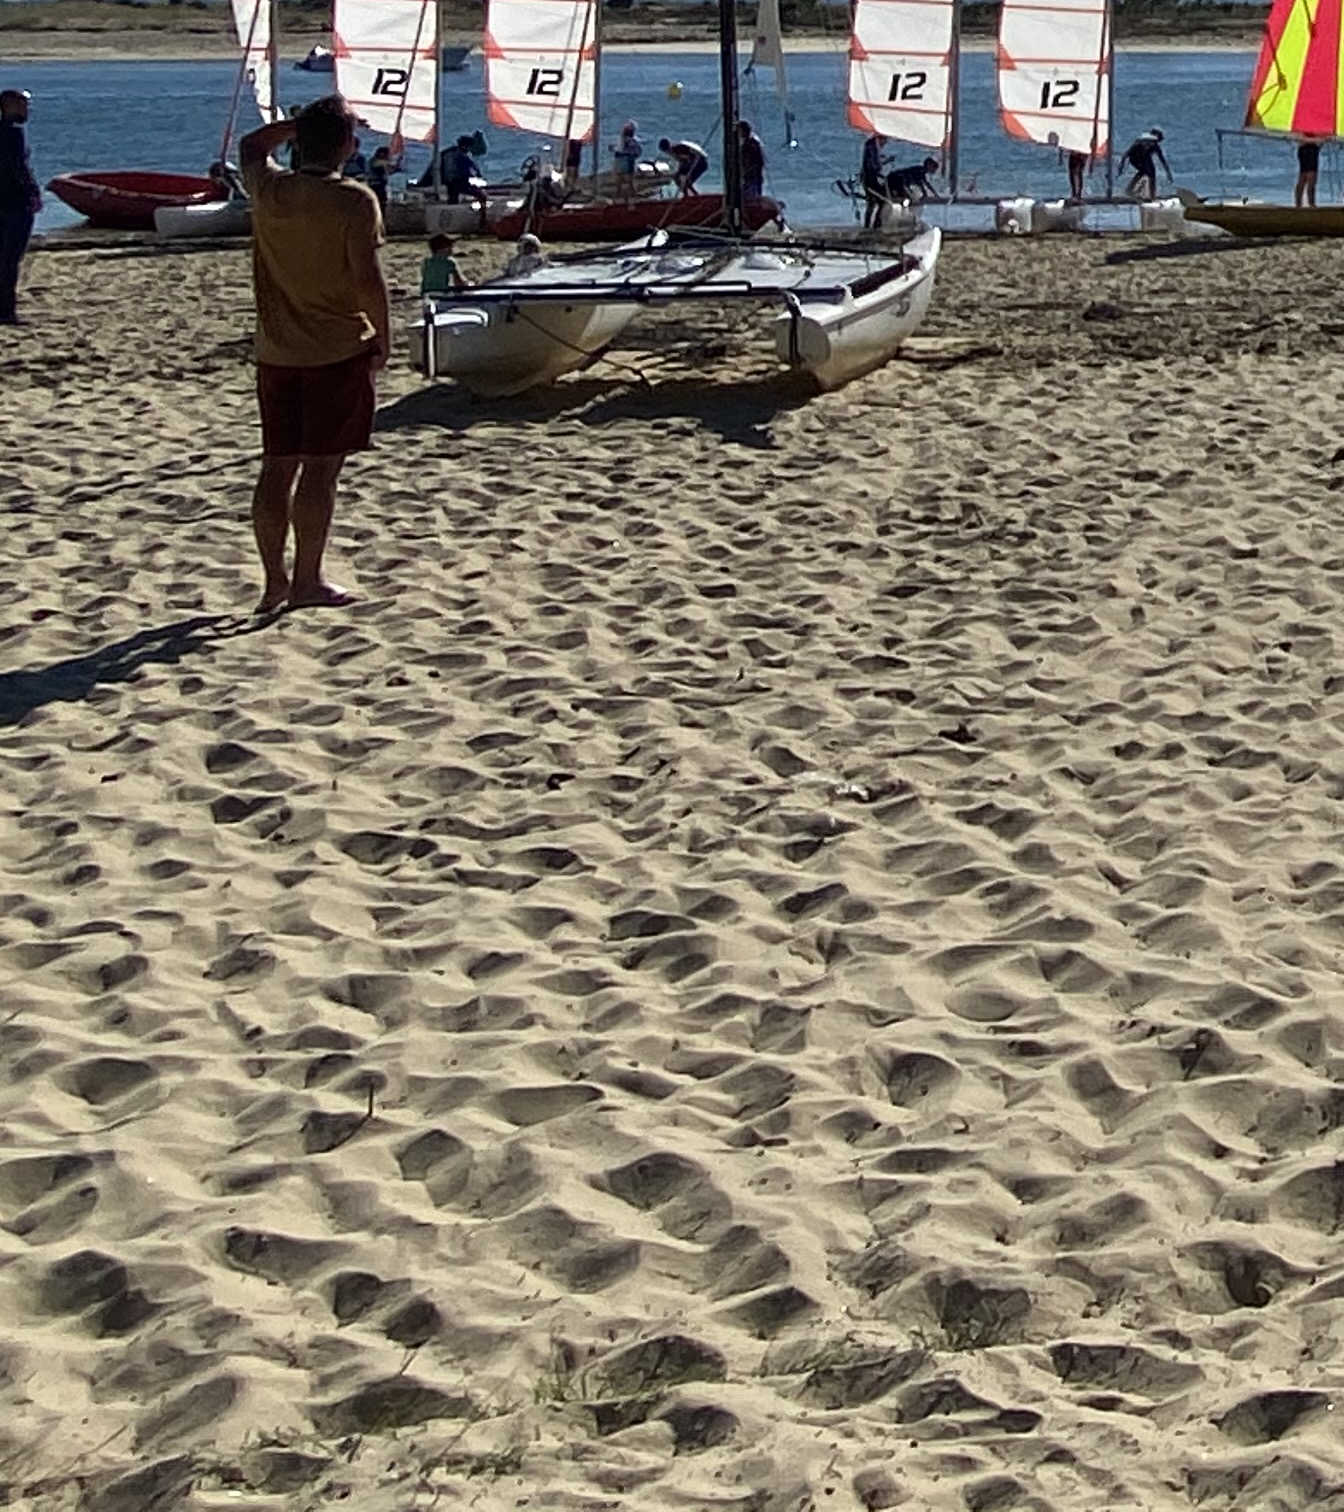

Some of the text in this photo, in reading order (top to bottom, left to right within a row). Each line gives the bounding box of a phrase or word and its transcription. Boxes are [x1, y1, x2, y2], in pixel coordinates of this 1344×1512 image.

[371, 68, 409, 97] 12
[525, 68, 564, 97] 12
[888, 71, 927, 102] 12
[1040, 80, 1080, 109] 12
